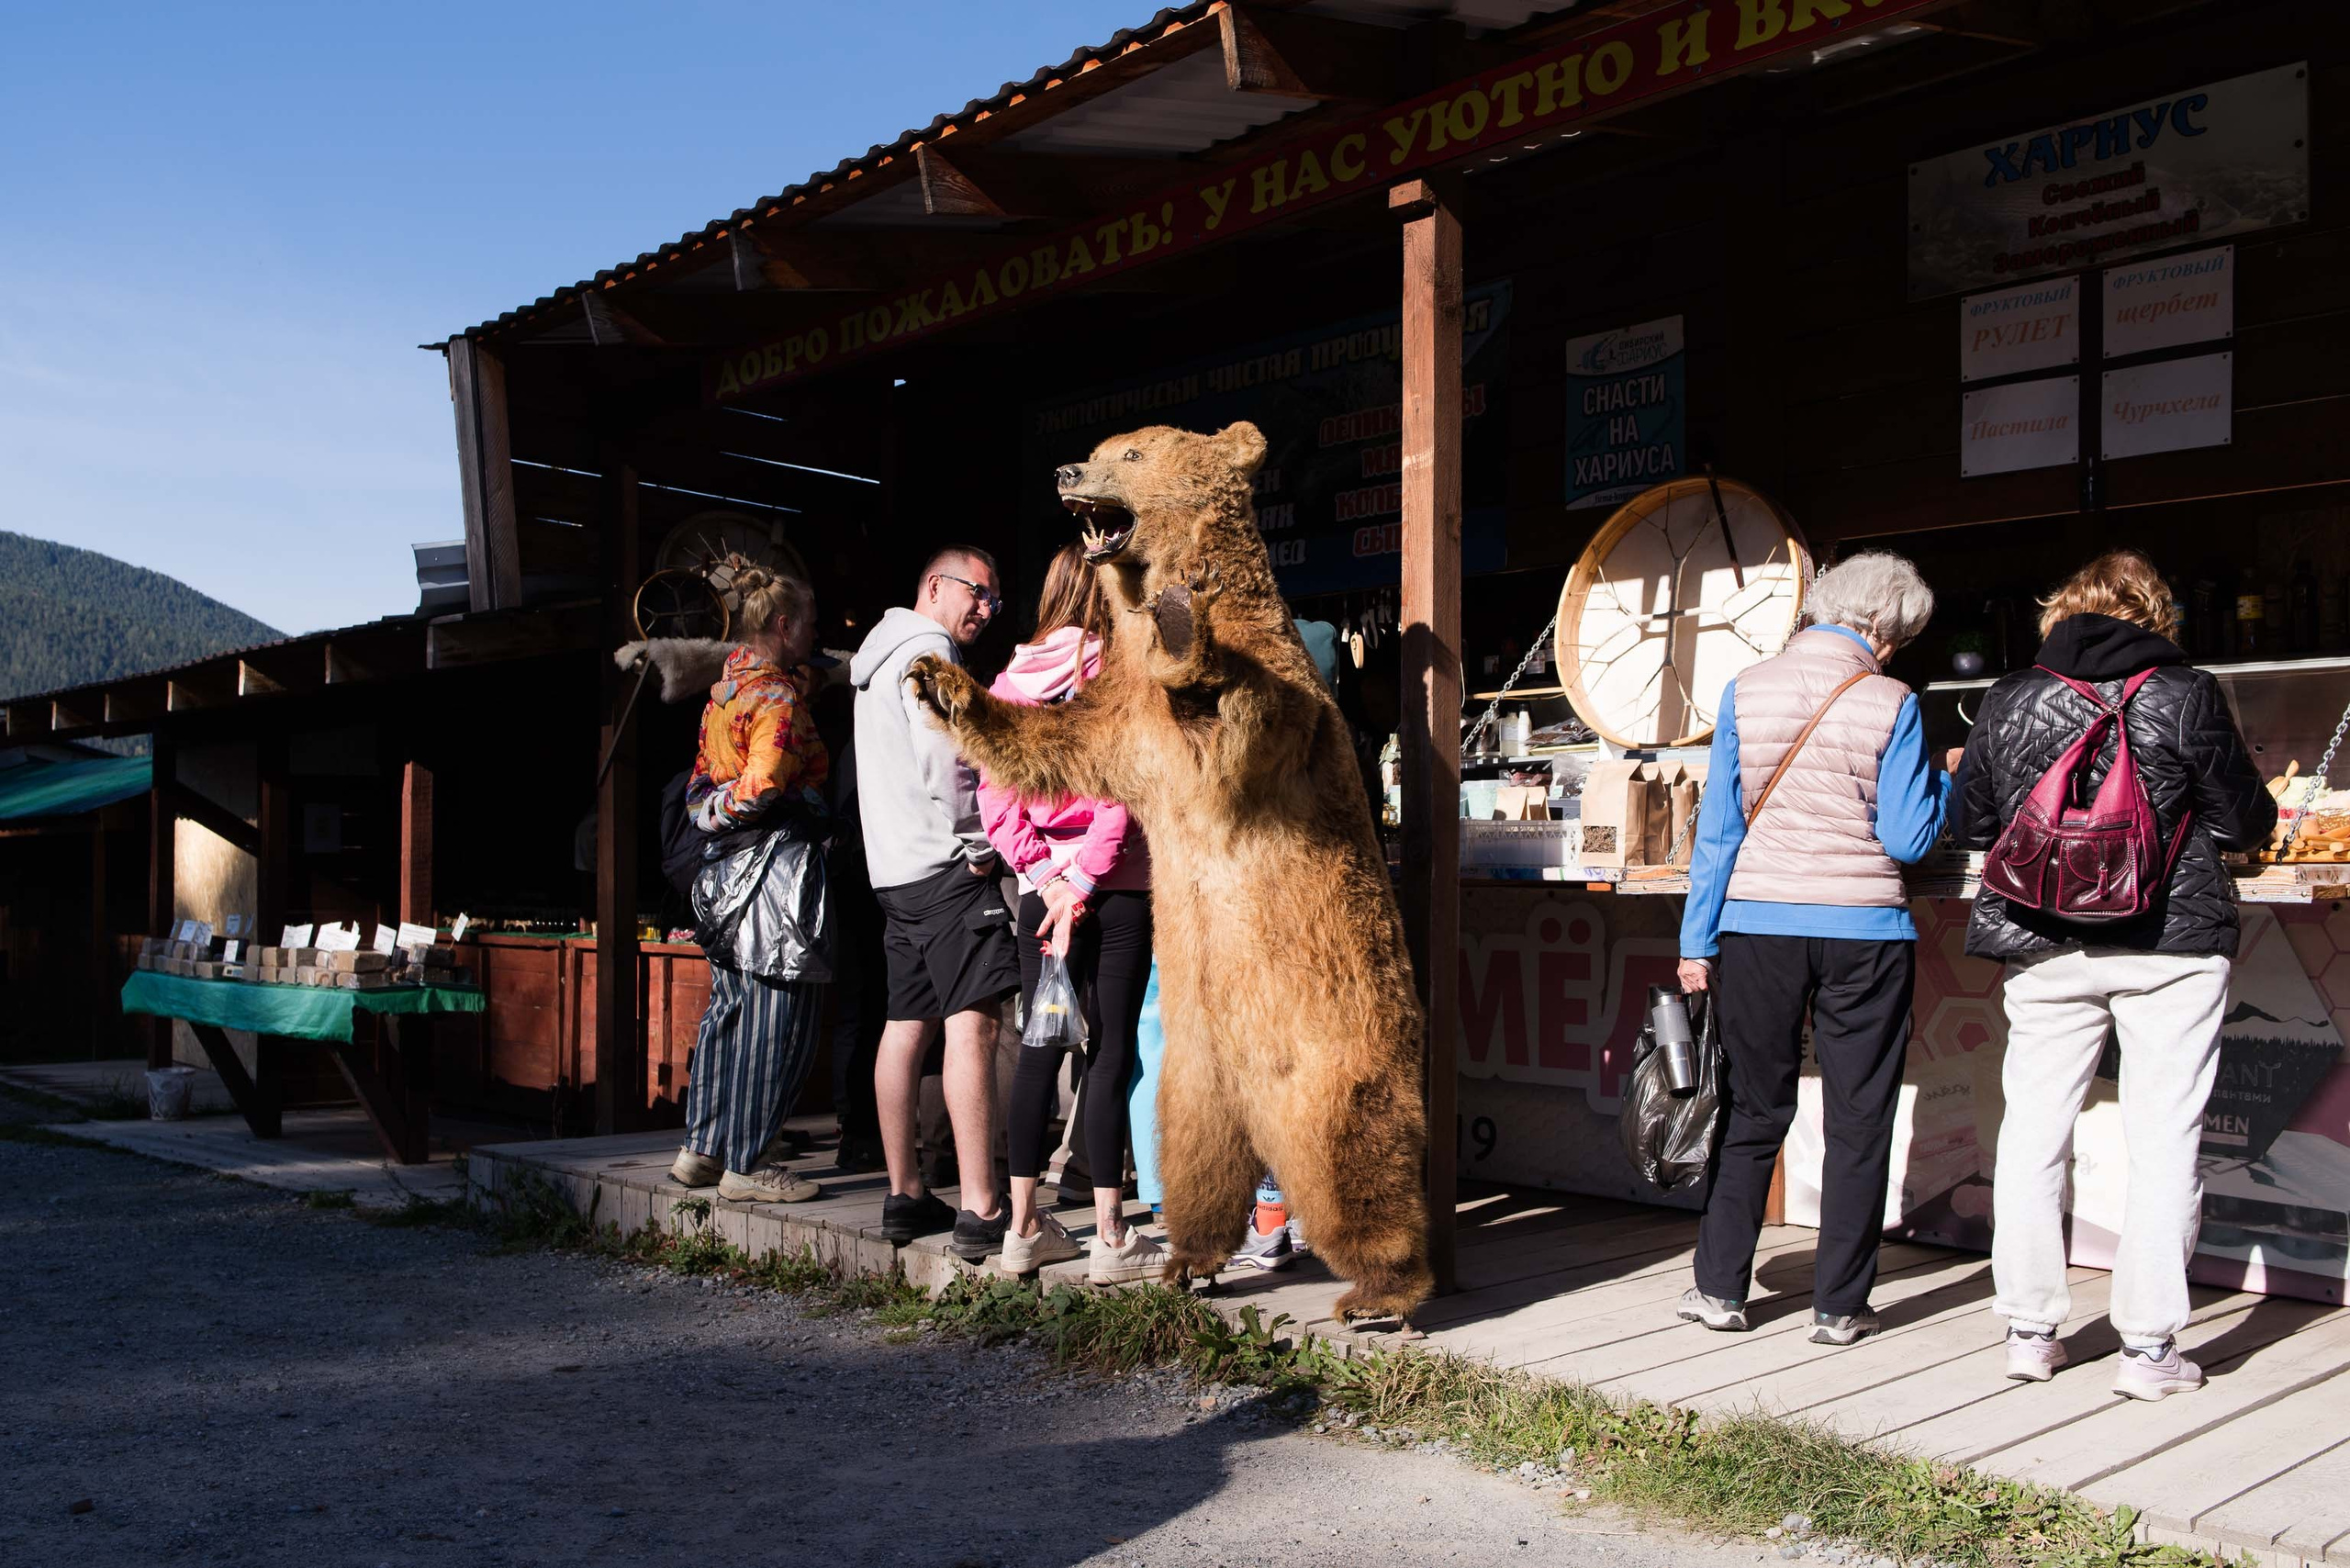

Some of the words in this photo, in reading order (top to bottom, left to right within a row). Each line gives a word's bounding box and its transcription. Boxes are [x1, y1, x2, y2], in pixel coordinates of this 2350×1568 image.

[715, 327, 830, 401] ДОБРО
[838, 200, 1175, 354] ПОЖАЛОВАТЬ!
[1199, 177, 1238, 230] У
[1248, 133, 1368, 216] НАС
[1382, 40, 1635, 166] УЮТНО
[1656, 11, 1711, 77] И
[2113, 254, 2225, 291] ФРУКТОВЫЙ
[1969, 282, 2073, 318] ФРУКТОВЫЙ
[2115, 288, 2220, 326] щербет
[1971, 312, 2073, 353] РУЛЕТ
[1582, 372, 1666, 417] СНАСТИ
[2111, 390, 2221, 425] Чурчхела
[1608, 414, 1640, 446] НА
[1970, 414, 2069, 441] Пастила
[1574, 442, 1677, 487] ХАРИУСА
[2220, 1059, 2283, 1088] ANT
